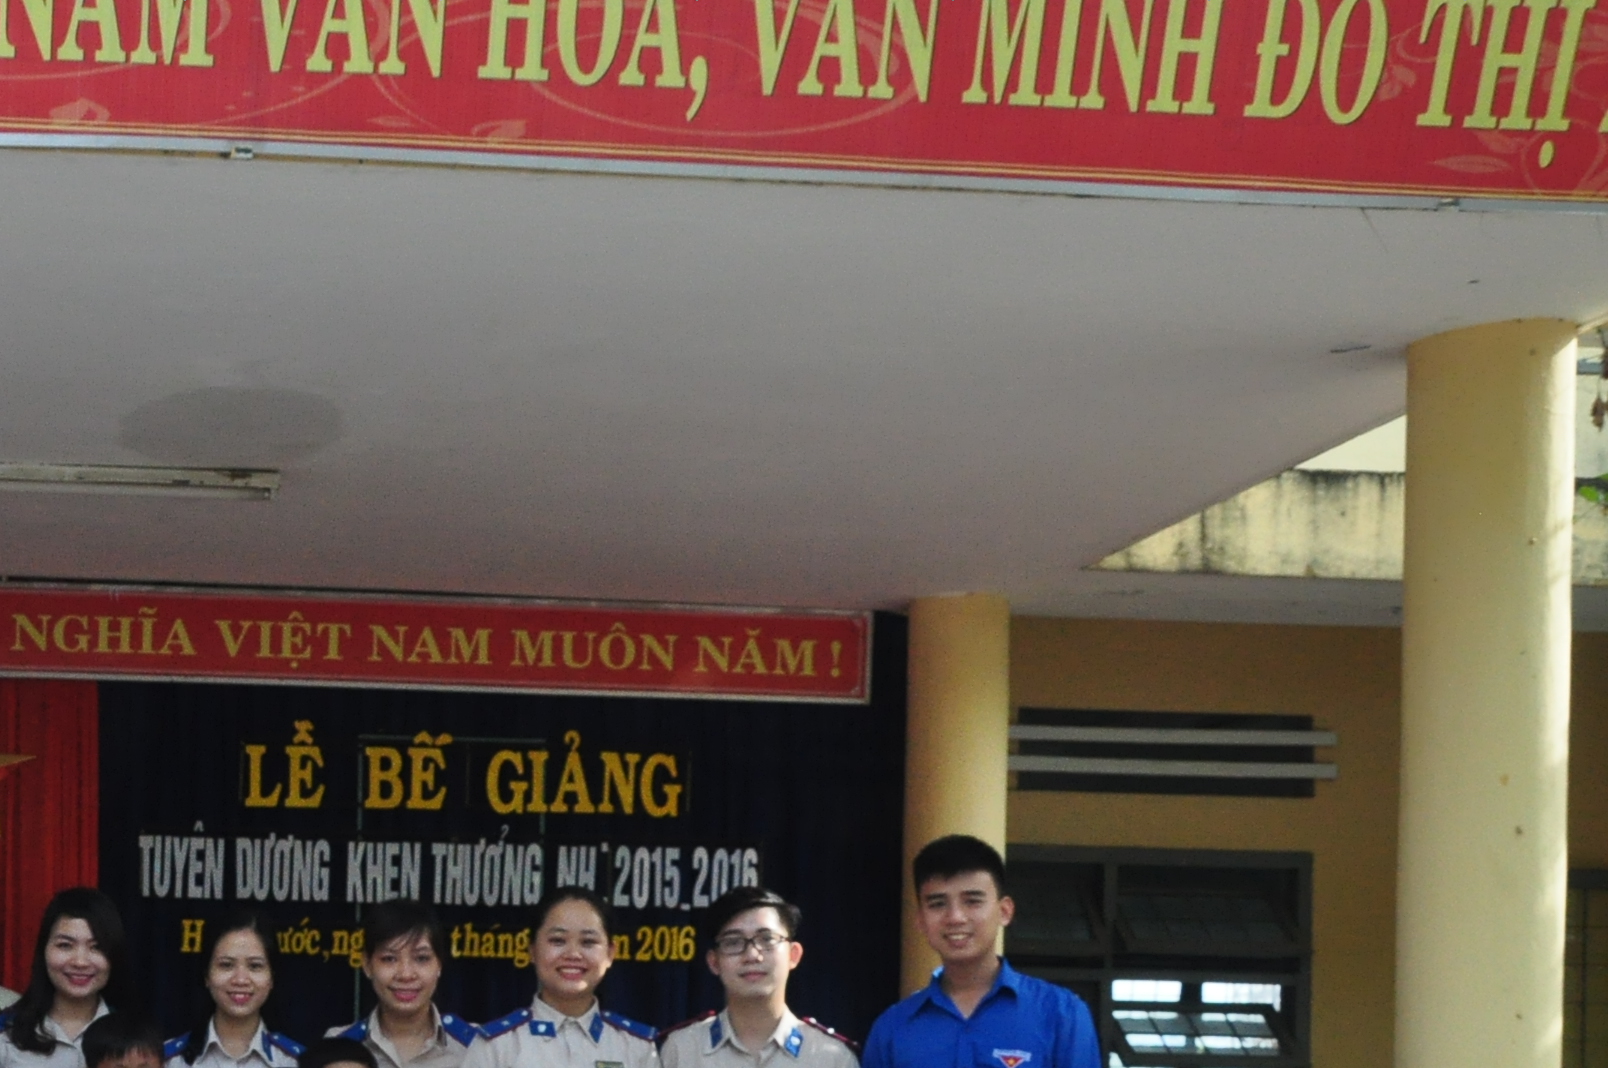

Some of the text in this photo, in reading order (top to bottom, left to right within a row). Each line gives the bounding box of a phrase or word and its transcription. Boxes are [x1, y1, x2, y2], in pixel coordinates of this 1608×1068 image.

[961, 0, 1223, 115] MINH
[1416, 0, 1594, 168] THỊ
[10, 606, 197, 656] NGHĨA
[216, 611, 352, 669] VIỆT
[369, 624, 492, 665] NAM
[512, 621, 678, 671] MUÔN
[244, 720, 683, 817] LỄ BẾ GIẢNG
[139, 821, 225, 899] TUYÊN
[236, 832, 330, 902] DƯƠNG
[346, 841, 421, 903] KHEN
[431, 825, 542, 906] THƯỞNG
[450, 921, 532, 969] tháng
[635, 925, 697, 962] 2016
